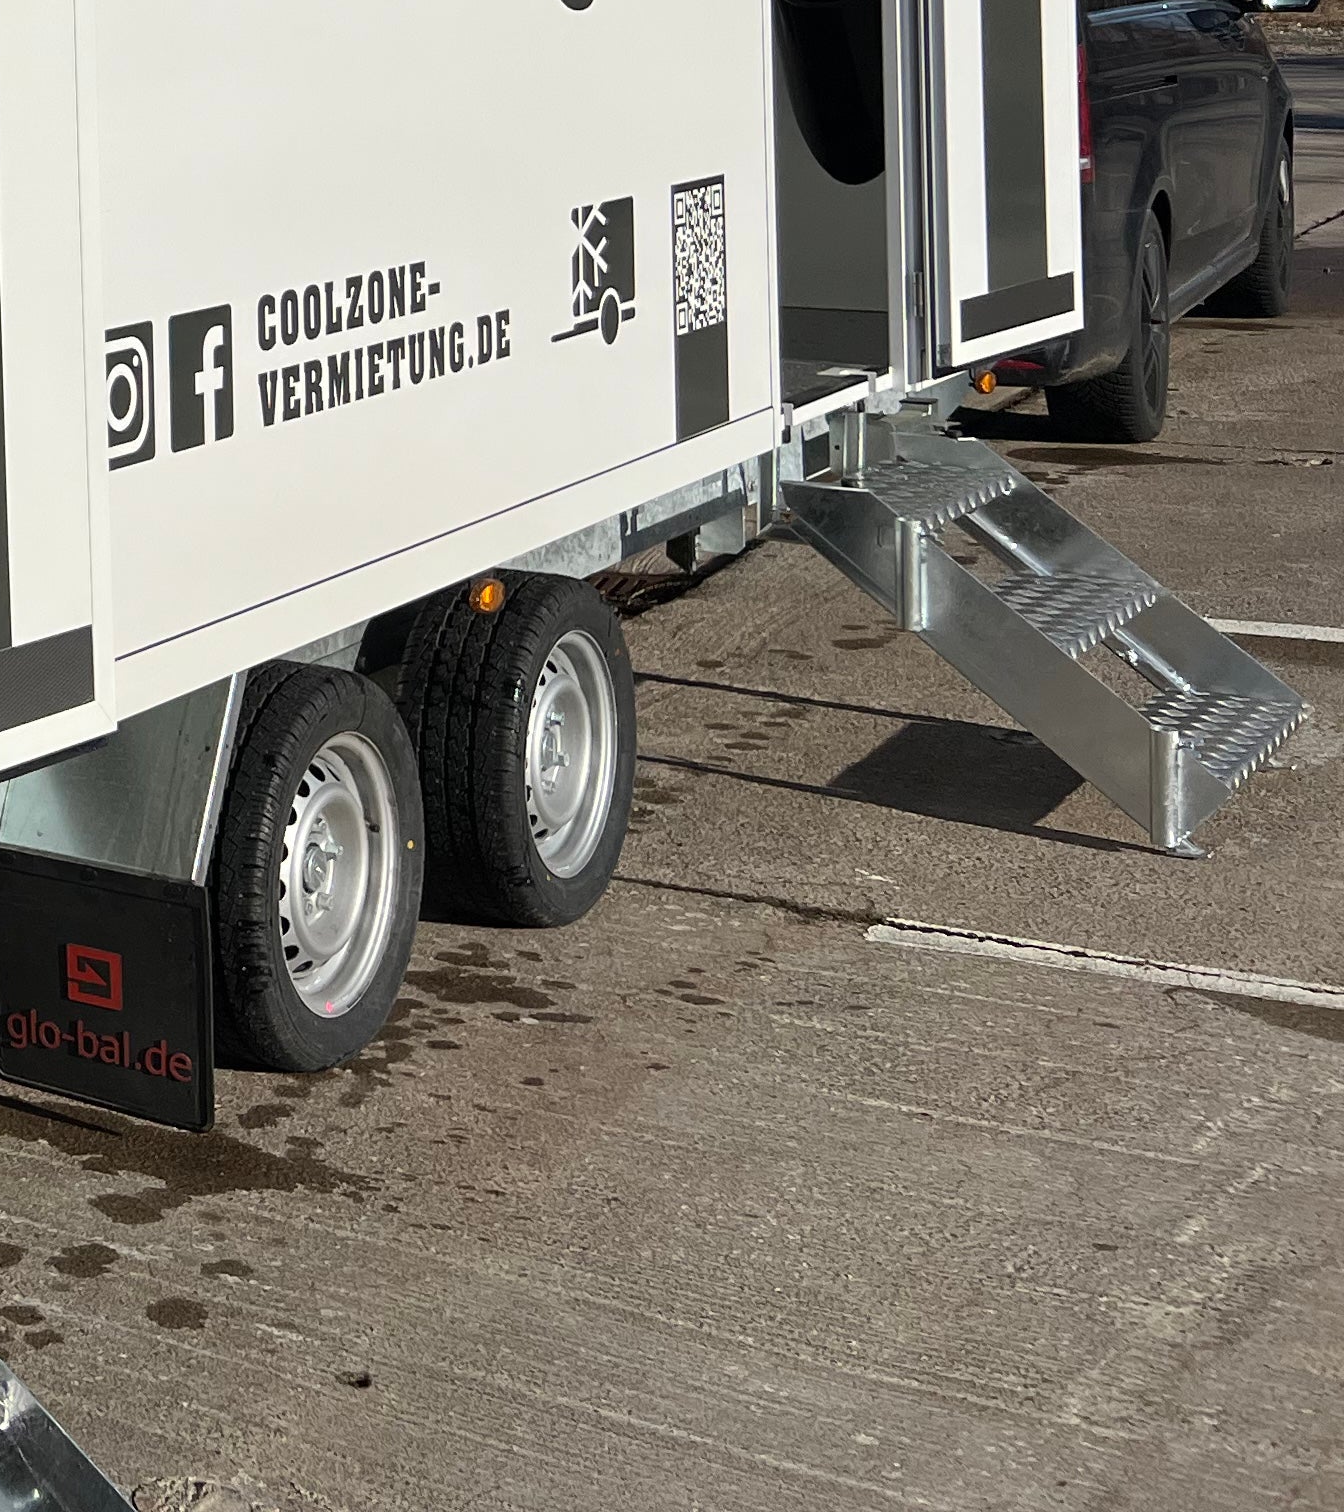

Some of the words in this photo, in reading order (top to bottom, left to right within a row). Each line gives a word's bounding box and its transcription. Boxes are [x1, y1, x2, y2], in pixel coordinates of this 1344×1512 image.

[258, 261, 440, 351] COOLZONE-
[258, 309, 511, 427] VERMIETUNG.DE
[7, 1008, 193, 1083] glo-bal.de
